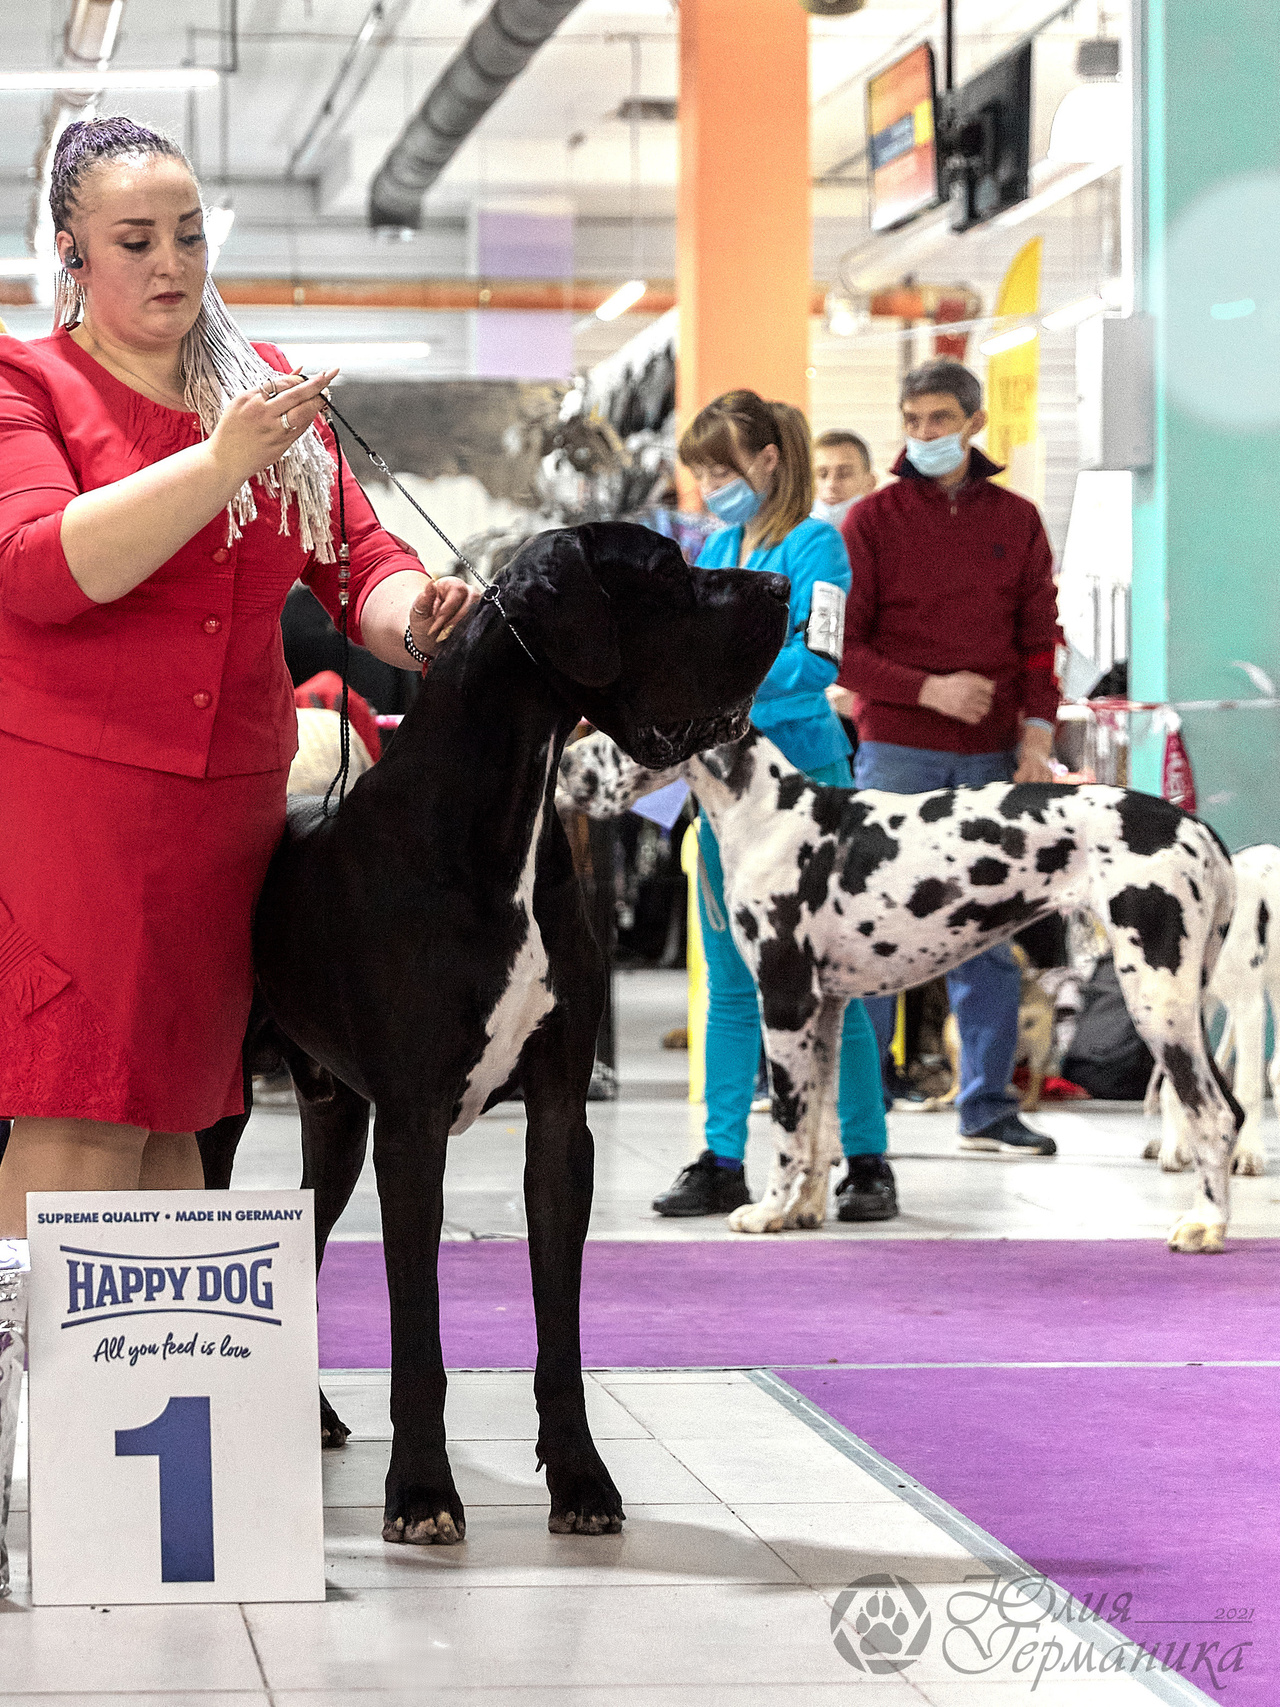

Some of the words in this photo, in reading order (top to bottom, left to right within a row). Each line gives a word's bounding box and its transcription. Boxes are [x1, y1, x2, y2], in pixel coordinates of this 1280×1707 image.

[37, 1212, 99, 1224] SUPREME
[102, 1211, 160, 1223] QUALITY
[175, 1211, 214, 1222] MADE
[217, 1210, 232, 1222] IN
[235, 1209, 303, 1221] GERMANY
[66, 1259, 191, 1314] HAPPY
[196, 1258, 274, 1310] DOG
[93, 1335, 125, 1363] All
[128, 1345, 160, 1366] you
[161, 1332, 198, 1360] feed
[201, 1341, 216, 1354] is
[220, 1335, 251, 1359] love
[114, 1396, 215, 1583] 1
